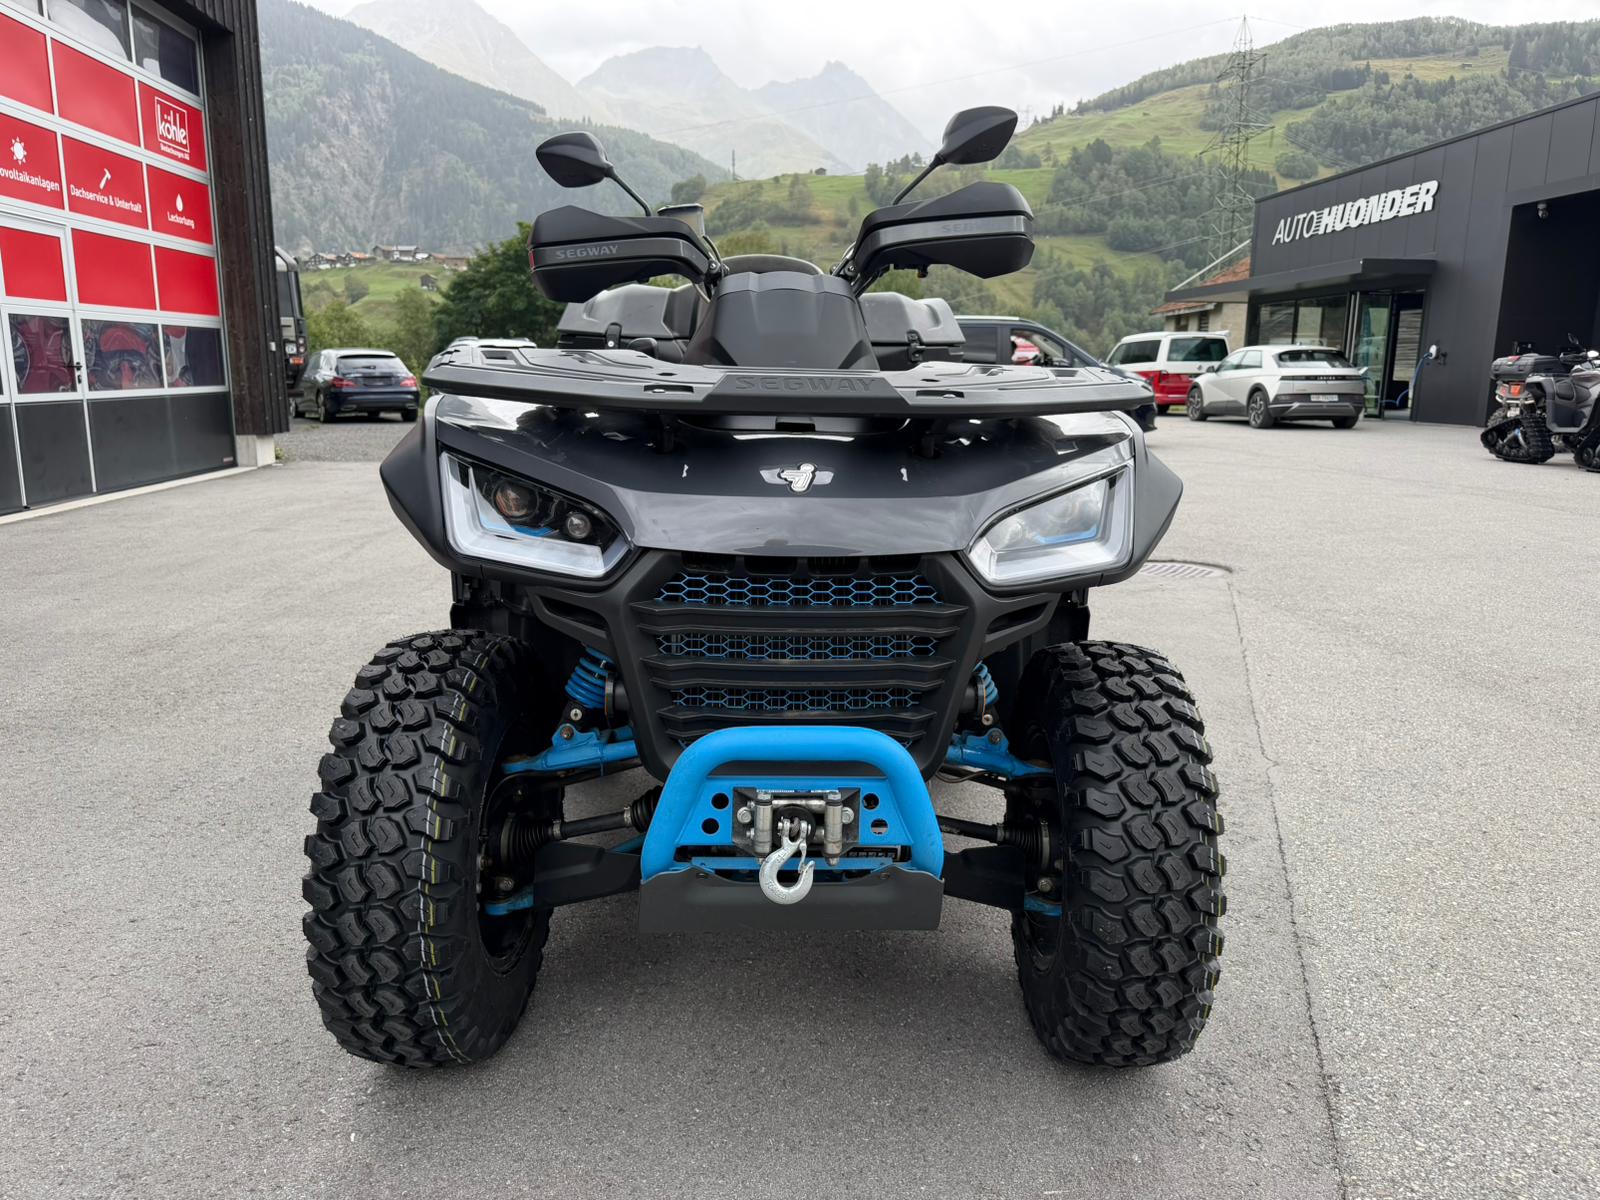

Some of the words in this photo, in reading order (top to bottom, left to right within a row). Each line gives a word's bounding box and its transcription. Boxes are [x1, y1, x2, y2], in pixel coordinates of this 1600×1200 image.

[70, 184, 108, 205] Dachservice
[555, 244, 619, 260] SEGWAY
[735, 376, 876, 393] SEGWAY
